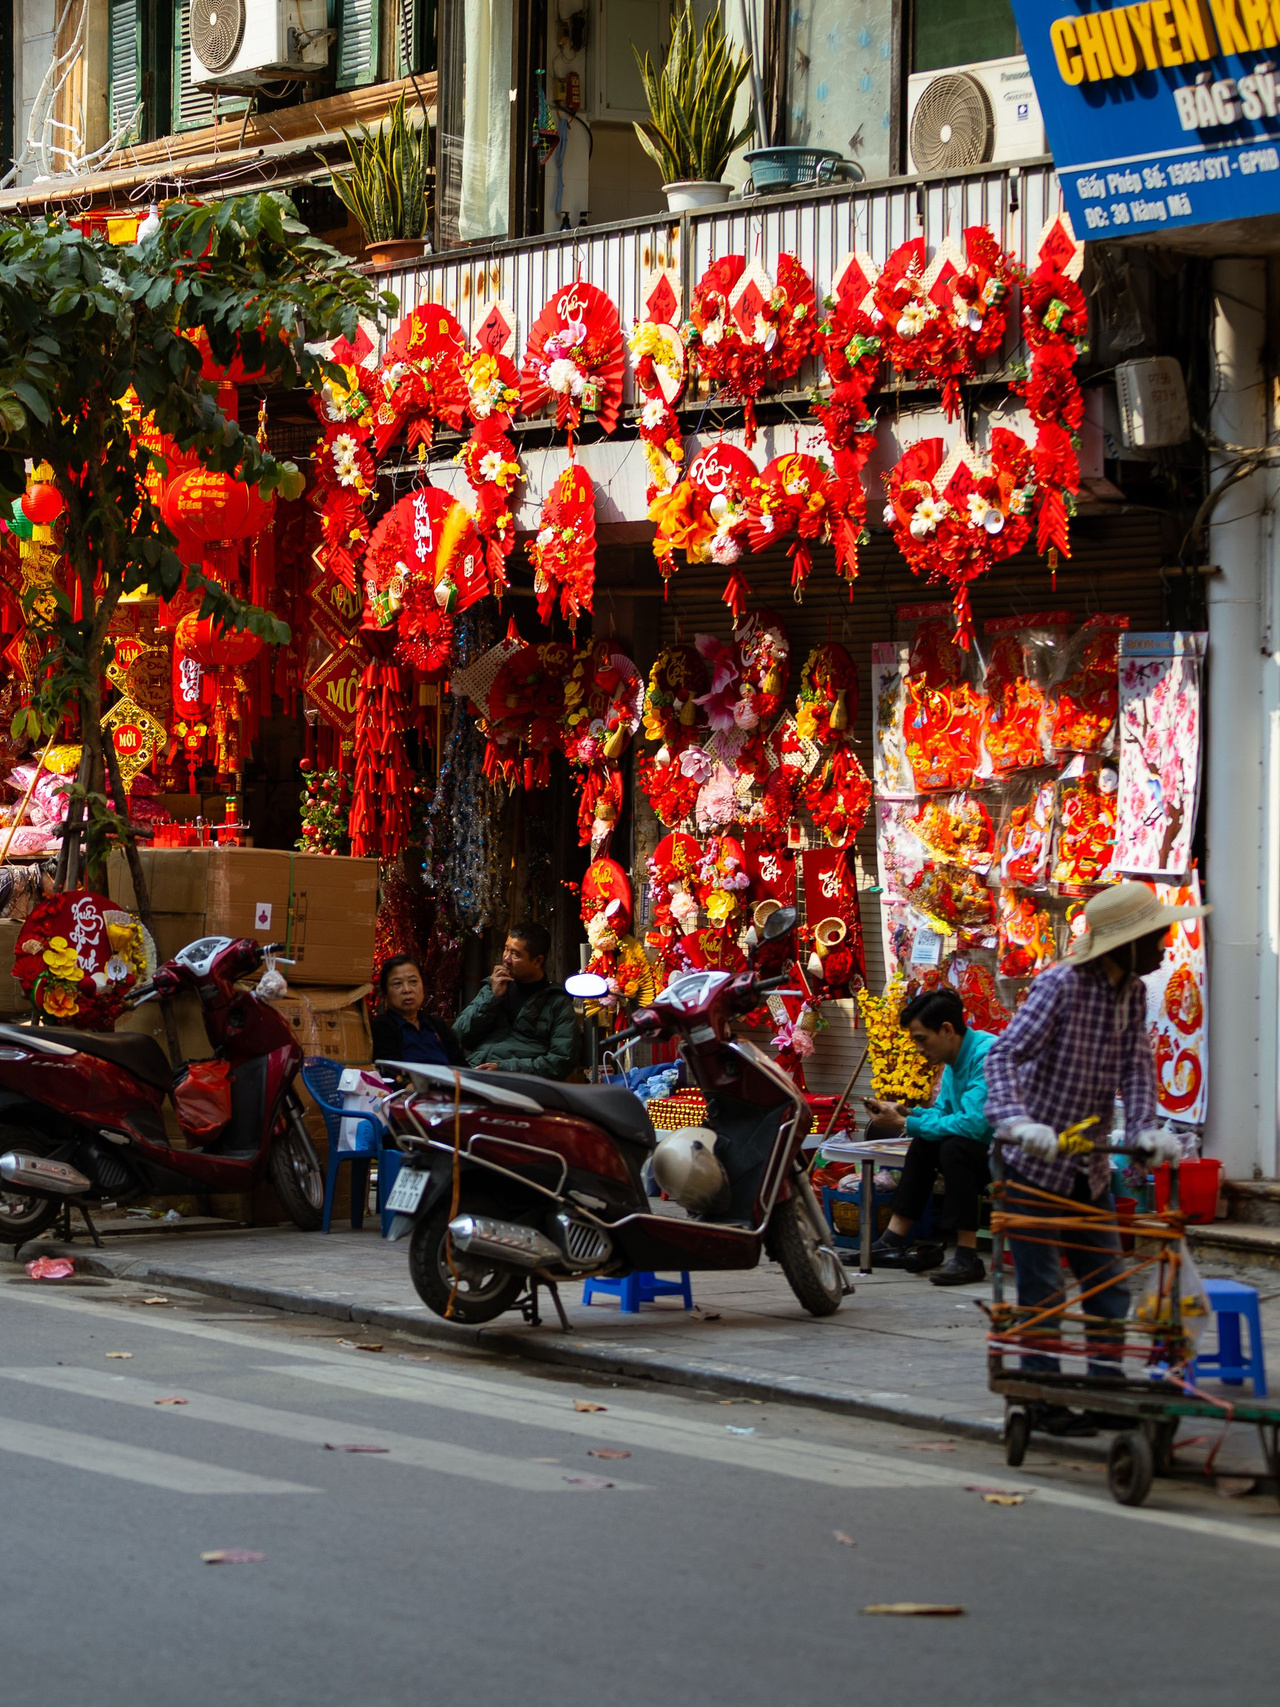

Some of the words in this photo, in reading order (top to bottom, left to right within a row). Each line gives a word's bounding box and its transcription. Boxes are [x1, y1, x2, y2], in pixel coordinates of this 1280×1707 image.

[1106, 169, 1143, 195] Phép
[118, 730, 137, 747] MỚI
[479, 1116, 531, 1129] LEAD
